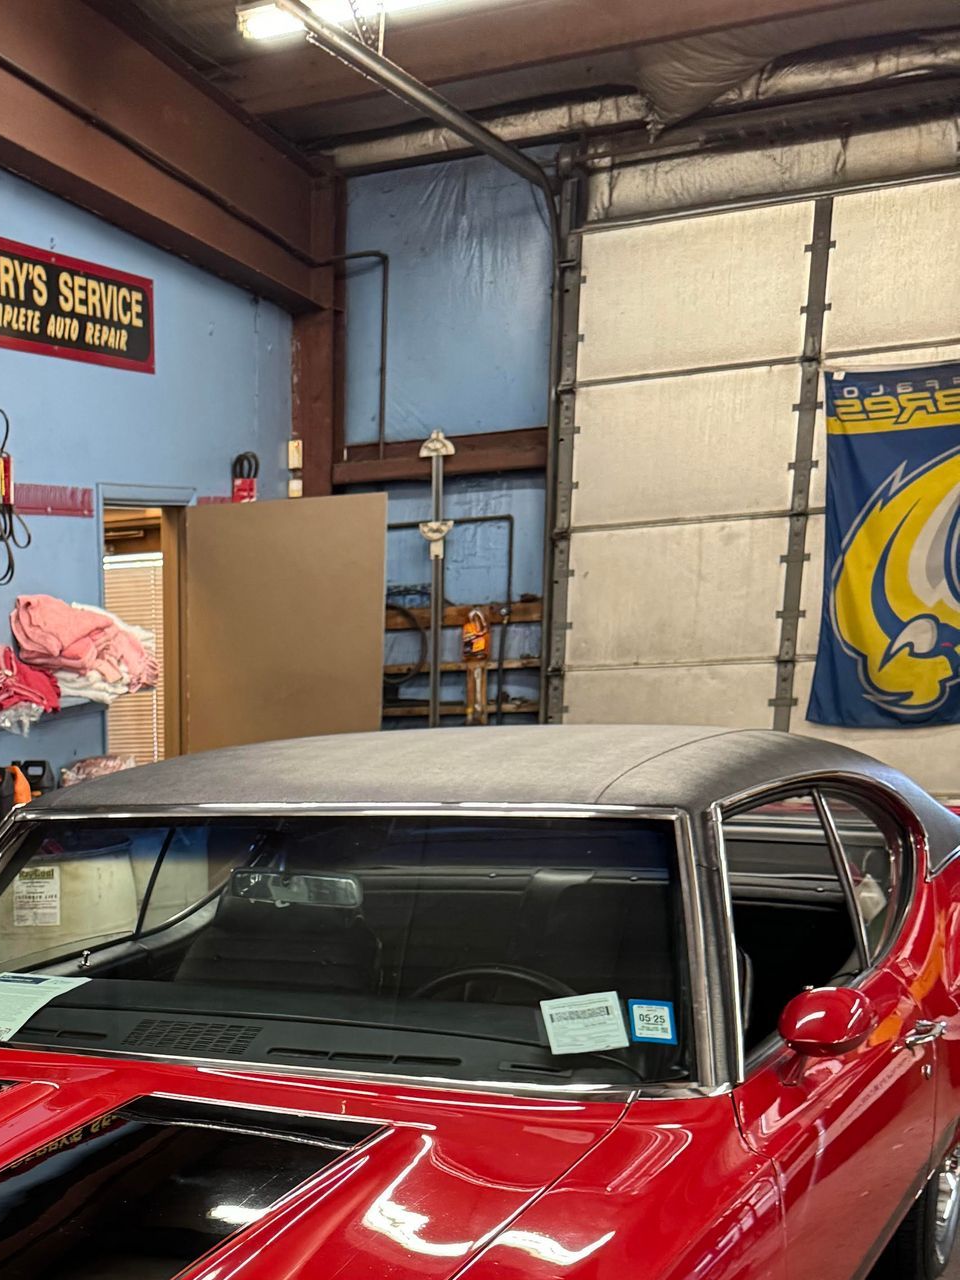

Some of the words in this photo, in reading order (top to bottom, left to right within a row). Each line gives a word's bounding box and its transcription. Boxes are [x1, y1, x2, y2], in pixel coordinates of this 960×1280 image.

[59, 271, 143, 328] SERVICE
[47, 314, 79, 342] AUTO
[85, 322, 128, 351] REPAIR
